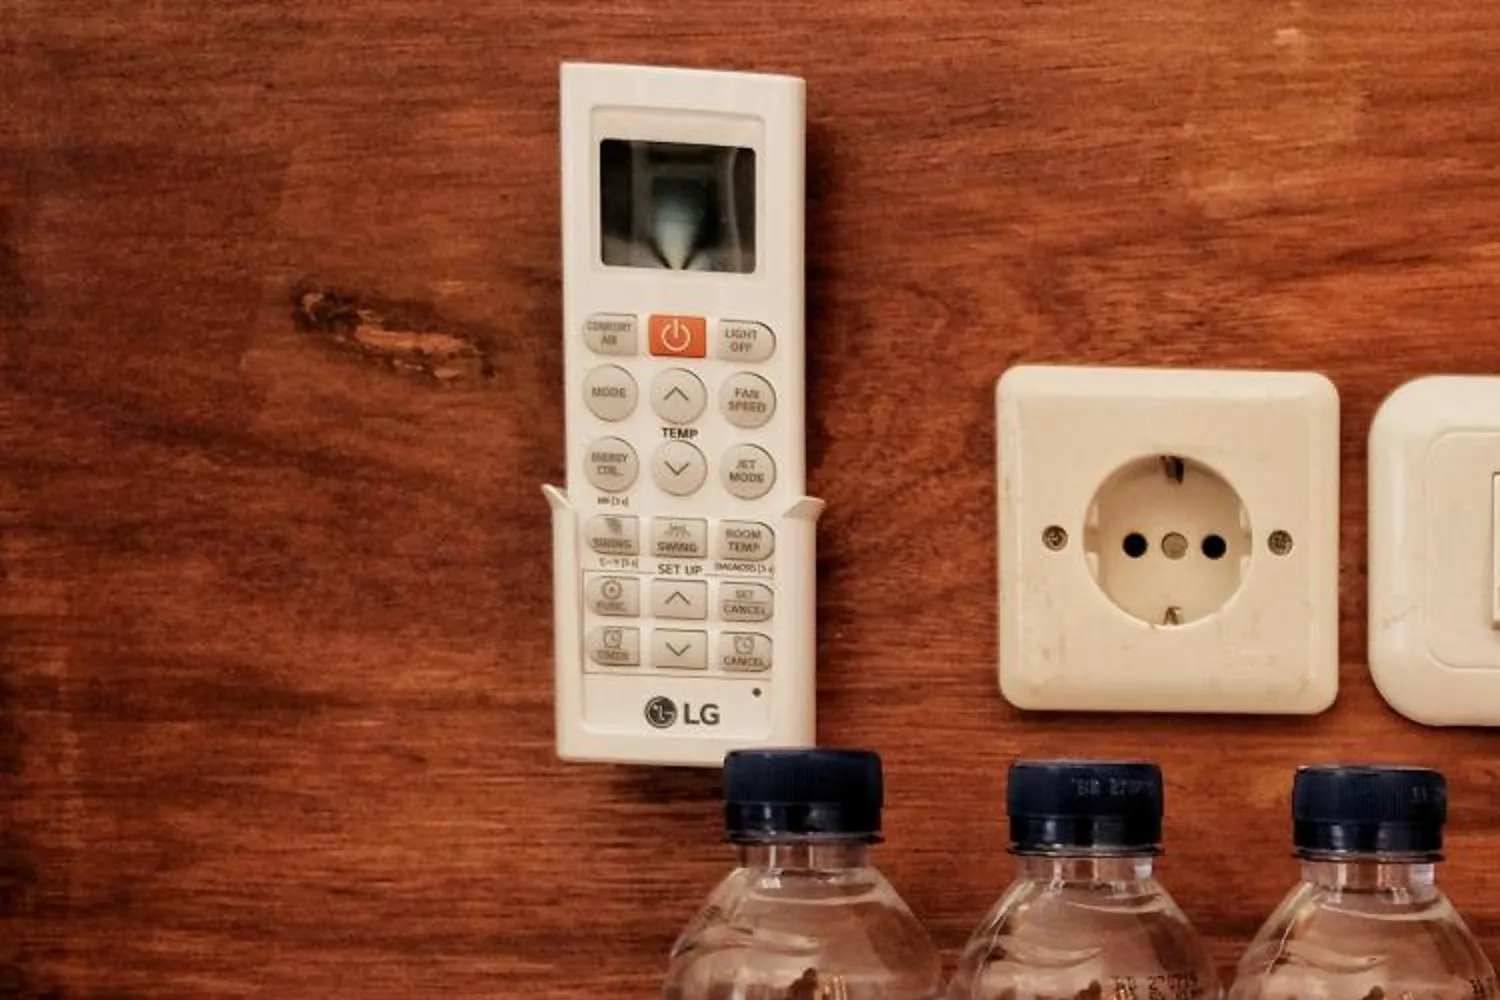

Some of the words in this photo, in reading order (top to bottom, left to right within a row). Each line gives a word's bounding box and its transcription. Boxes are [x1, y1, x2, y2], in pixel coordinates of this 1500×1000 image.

[725, 329, 758, 341] LIGHT
[591, 386, 627, 399] MODE
[734, 387, 760, 400] FAN
[728, 400, 767, 414] SPEED
[661, 426, 699, 440] TEMP
[736, 458, 756, 470] JET
[729, 471, 765, 483] MODE
[725, 528, 761, 540] ROOM
[656, 541, 697, 553] SWING
[728, 541, 761, 553] TEMP
[657, 563, 681, 576] SET
[684, 564, 703, 577] UP
[723, 603, 767, 616] CANCEL
[723, 654, 766, 668] CANCEL
[683, 702, 720, 726] LG
